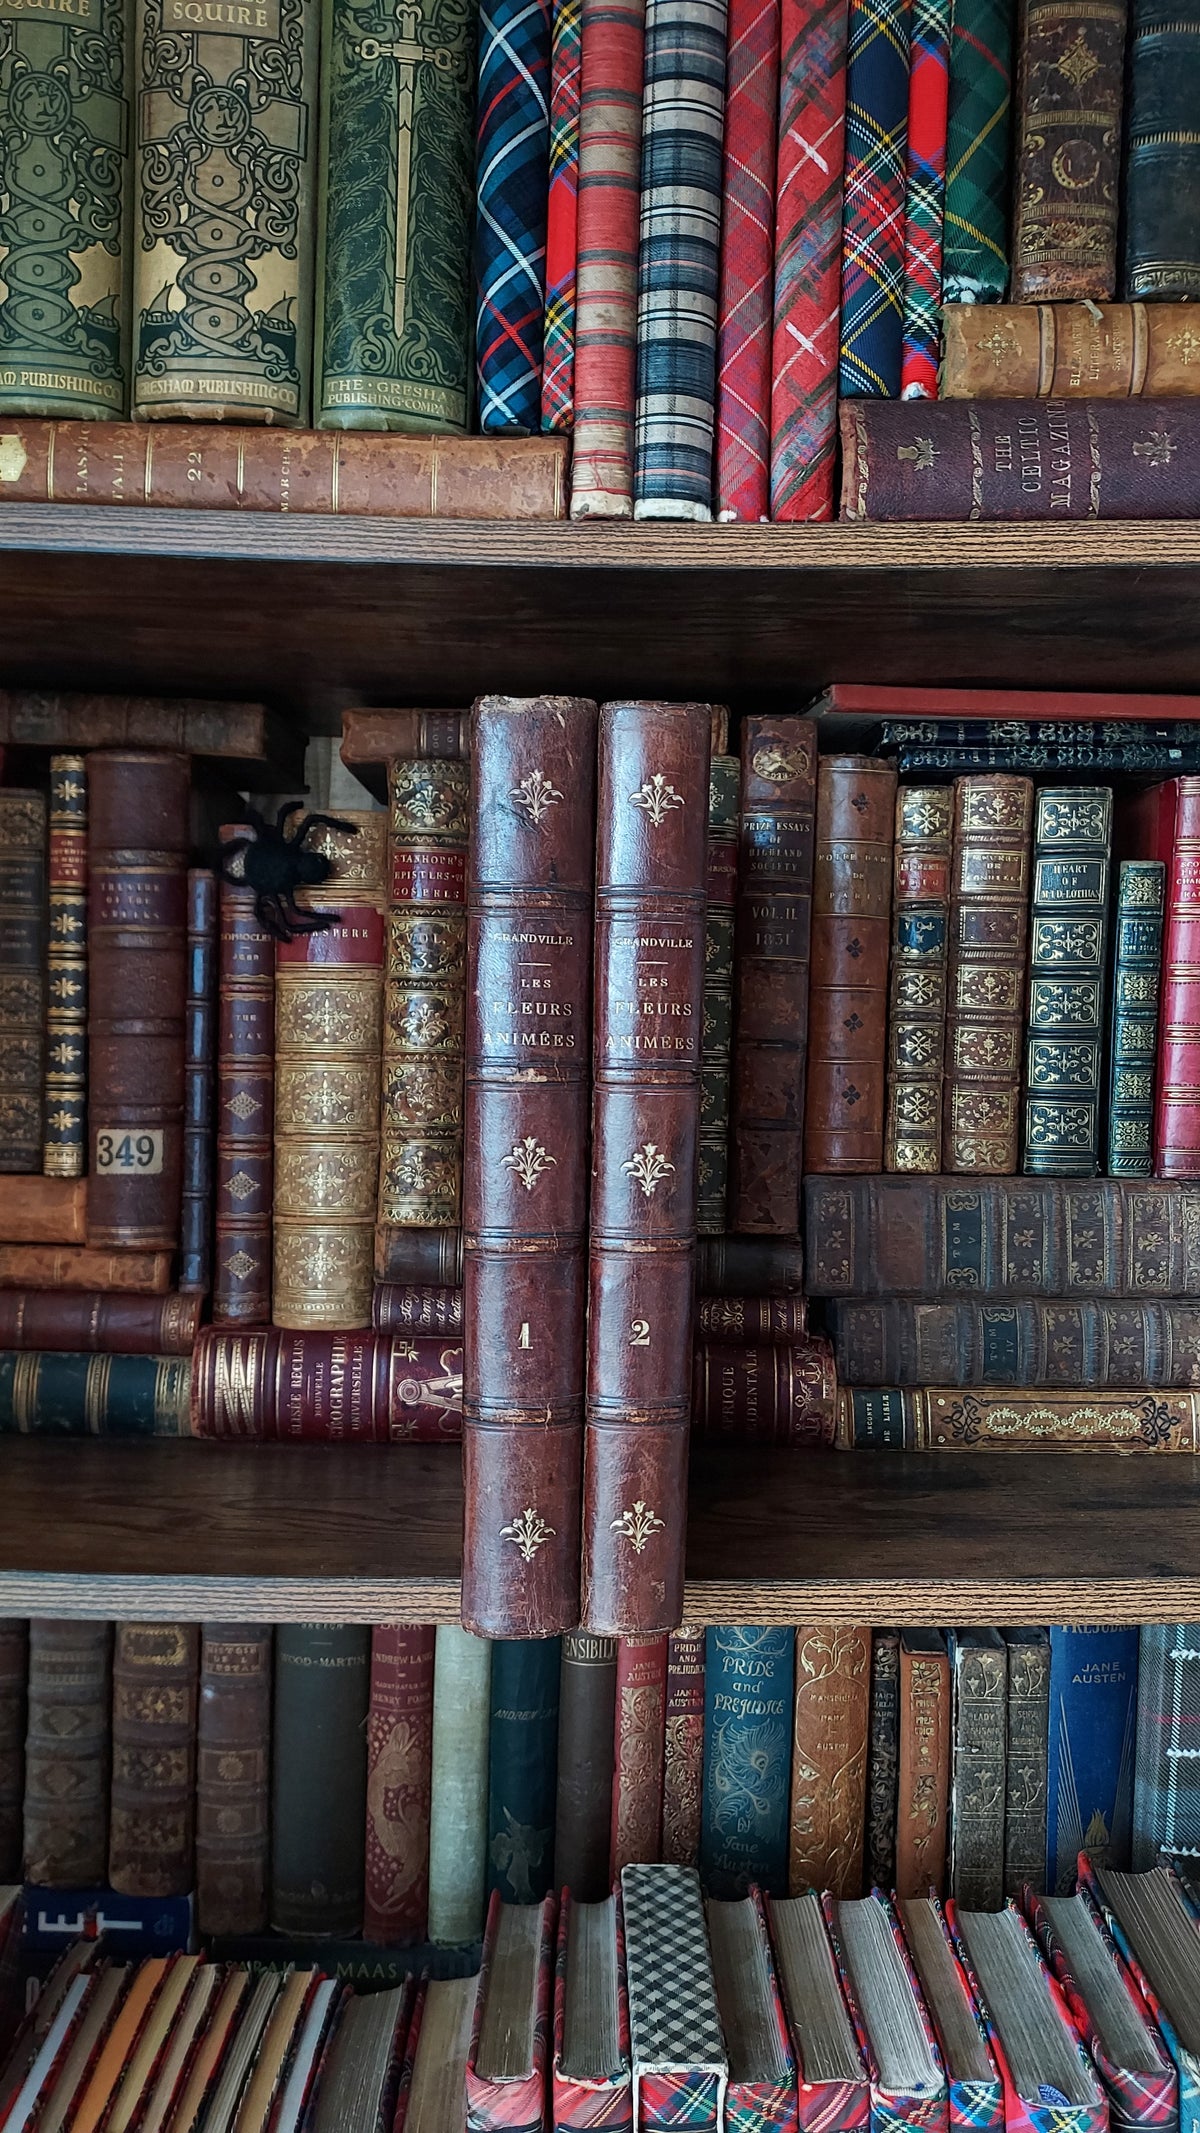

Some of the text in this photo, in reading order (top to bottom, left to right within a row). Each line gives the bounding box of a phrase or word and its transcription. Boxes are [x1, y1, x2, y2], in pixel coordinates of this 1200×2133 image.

[172, 2, 268, 27] SQUIRE
[20, 371, 102, 395] PUBLISHING
[198, 379, 277, 399] PUBLISHING
[328, 379, 363, 392] THE
[995, 435, 1012, 472] THE
[1018, 417, 1041, 493] CELTIC
[1046, 401, 1071, 508] MAGAZINE
[743, 822, 810, 832] PRIZE ESSAYS
[769, 836, 782, 844] OF
[751, 862, 797, 872] SOCIETY
[1053, 865, 1088, 874] HEART
[1062, 877, 1078, 886] OF
[494, 933, 573, 946] GRANDVILLE
[615, 937, 694, 949] GRANDVILLE
[521, 979, 552, 988] LES
[638, 978, 668, 988] LES
[494, 1002, 572, 1017] FLEURS
[615, 1001, 693, 1016] FLEURS
[483, 1031, 575, 1048] ANIMÉES
[98, 1135, 155, 1167] 349
[952, 1222, 961, 1258] TOM
[968, 1237, 976, 1245] V
[518, 1322, 534, 1350] 1
[629, 1319, 651, 1346] 2
[988, 1327, 998, 1361] TOM
[1005, 1339, 1015, 1353] IV
[291, 1339, 305, 1388] RECLUS
[314, 1362, 324, 1417] NOUVELLE
[351, 1345, 363, 1431] UNIVERSELLE
[882, 1395, 891, 1442] DE LISLE
[674, 1643, 702, 1653] PRIDE
[374, 1653, 408, 1665] NDREW
[633, 1661, 657, 1671] JANE
[679, 1654, 697, 1663] AND
[722, 1656, 775, 1677] PRIDE
[1081, 1661, 1121, 1672] JANE
[1072, 1672, 1127, 1684] AUSTEN
[733, 1681, 764, 1693] and
[714, 1693, 786, 1719] PREJUDICE
[973, 1713, 995, 1721] LADY
[722, 1836, 760, 1853] Jane
[337, 1961, 398, 1979] MAAS
